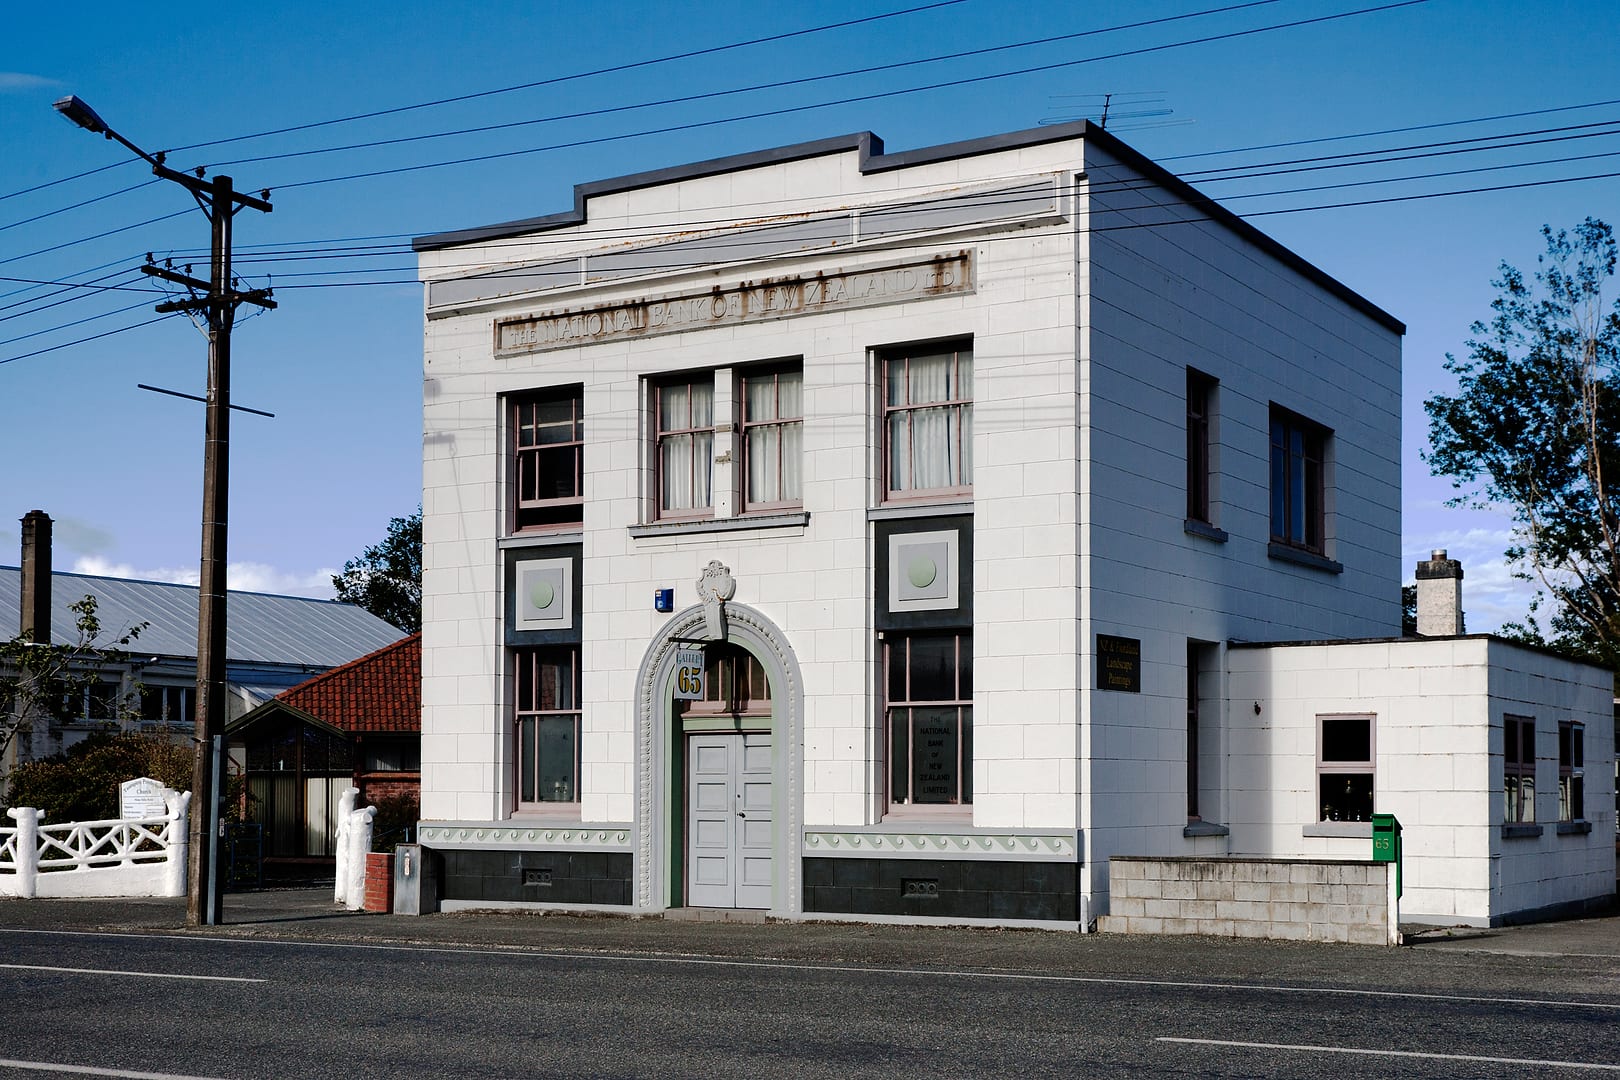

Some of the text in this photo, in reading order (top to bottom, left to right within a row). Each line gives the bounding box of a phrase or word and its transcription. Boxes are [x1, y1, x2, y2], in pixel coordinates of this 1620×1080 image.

[510, 269, 956, 347] THE NATIONAL BANK OF NEW ZEALAND LTD
[676, 652, 703, 667] GALLERY
[678, 665, 702, 695] 65
[919, 727, 952, 735] NATIONAL
[927, 739, 944, 747] BANK
[928, 762, 943, 770] NEW
[919, 774, 951, 782] ZEALAND
[923, 786, 948, 794] LIMITED
[1375, 838, 1389, 850] 65
